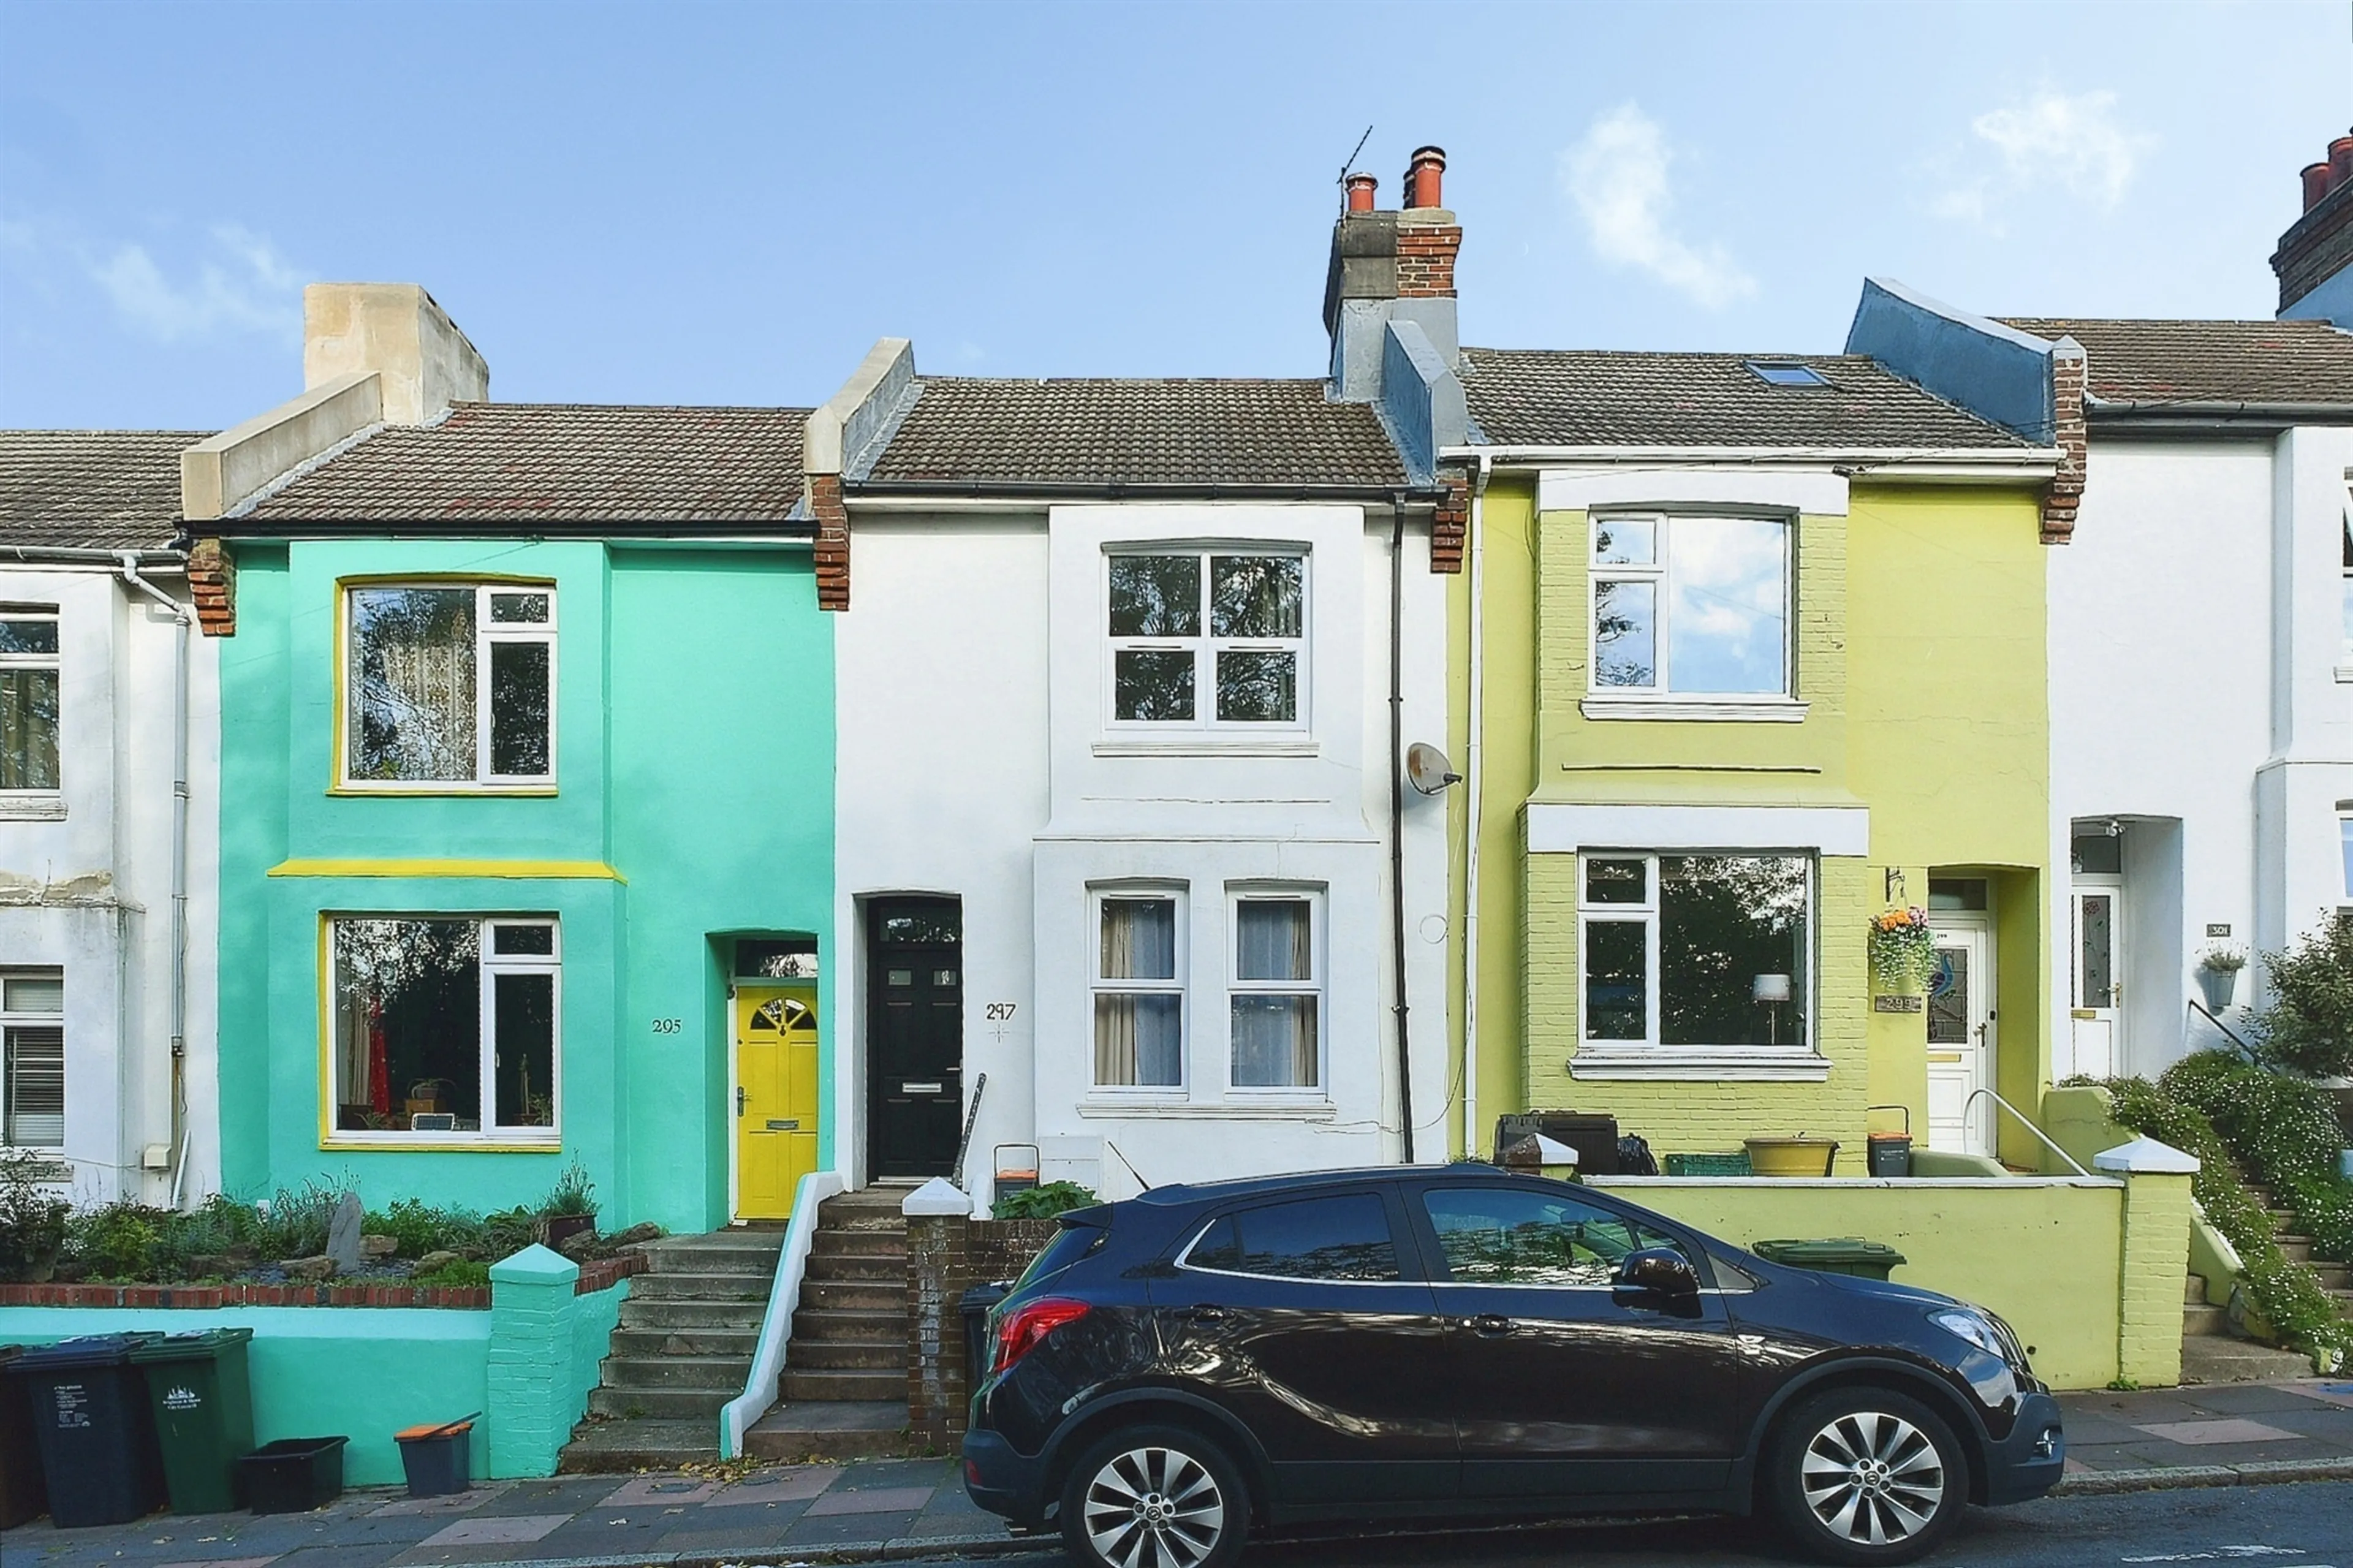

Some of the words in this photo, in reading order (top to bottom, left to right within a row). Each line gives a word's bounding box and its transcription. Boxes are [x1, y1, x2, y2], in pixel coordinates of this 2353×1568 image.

[987, 1003, 1016, 1020] 297
[1887, 998, 1911, 1009] 299
[652, 1018, 681, 1034] 295
